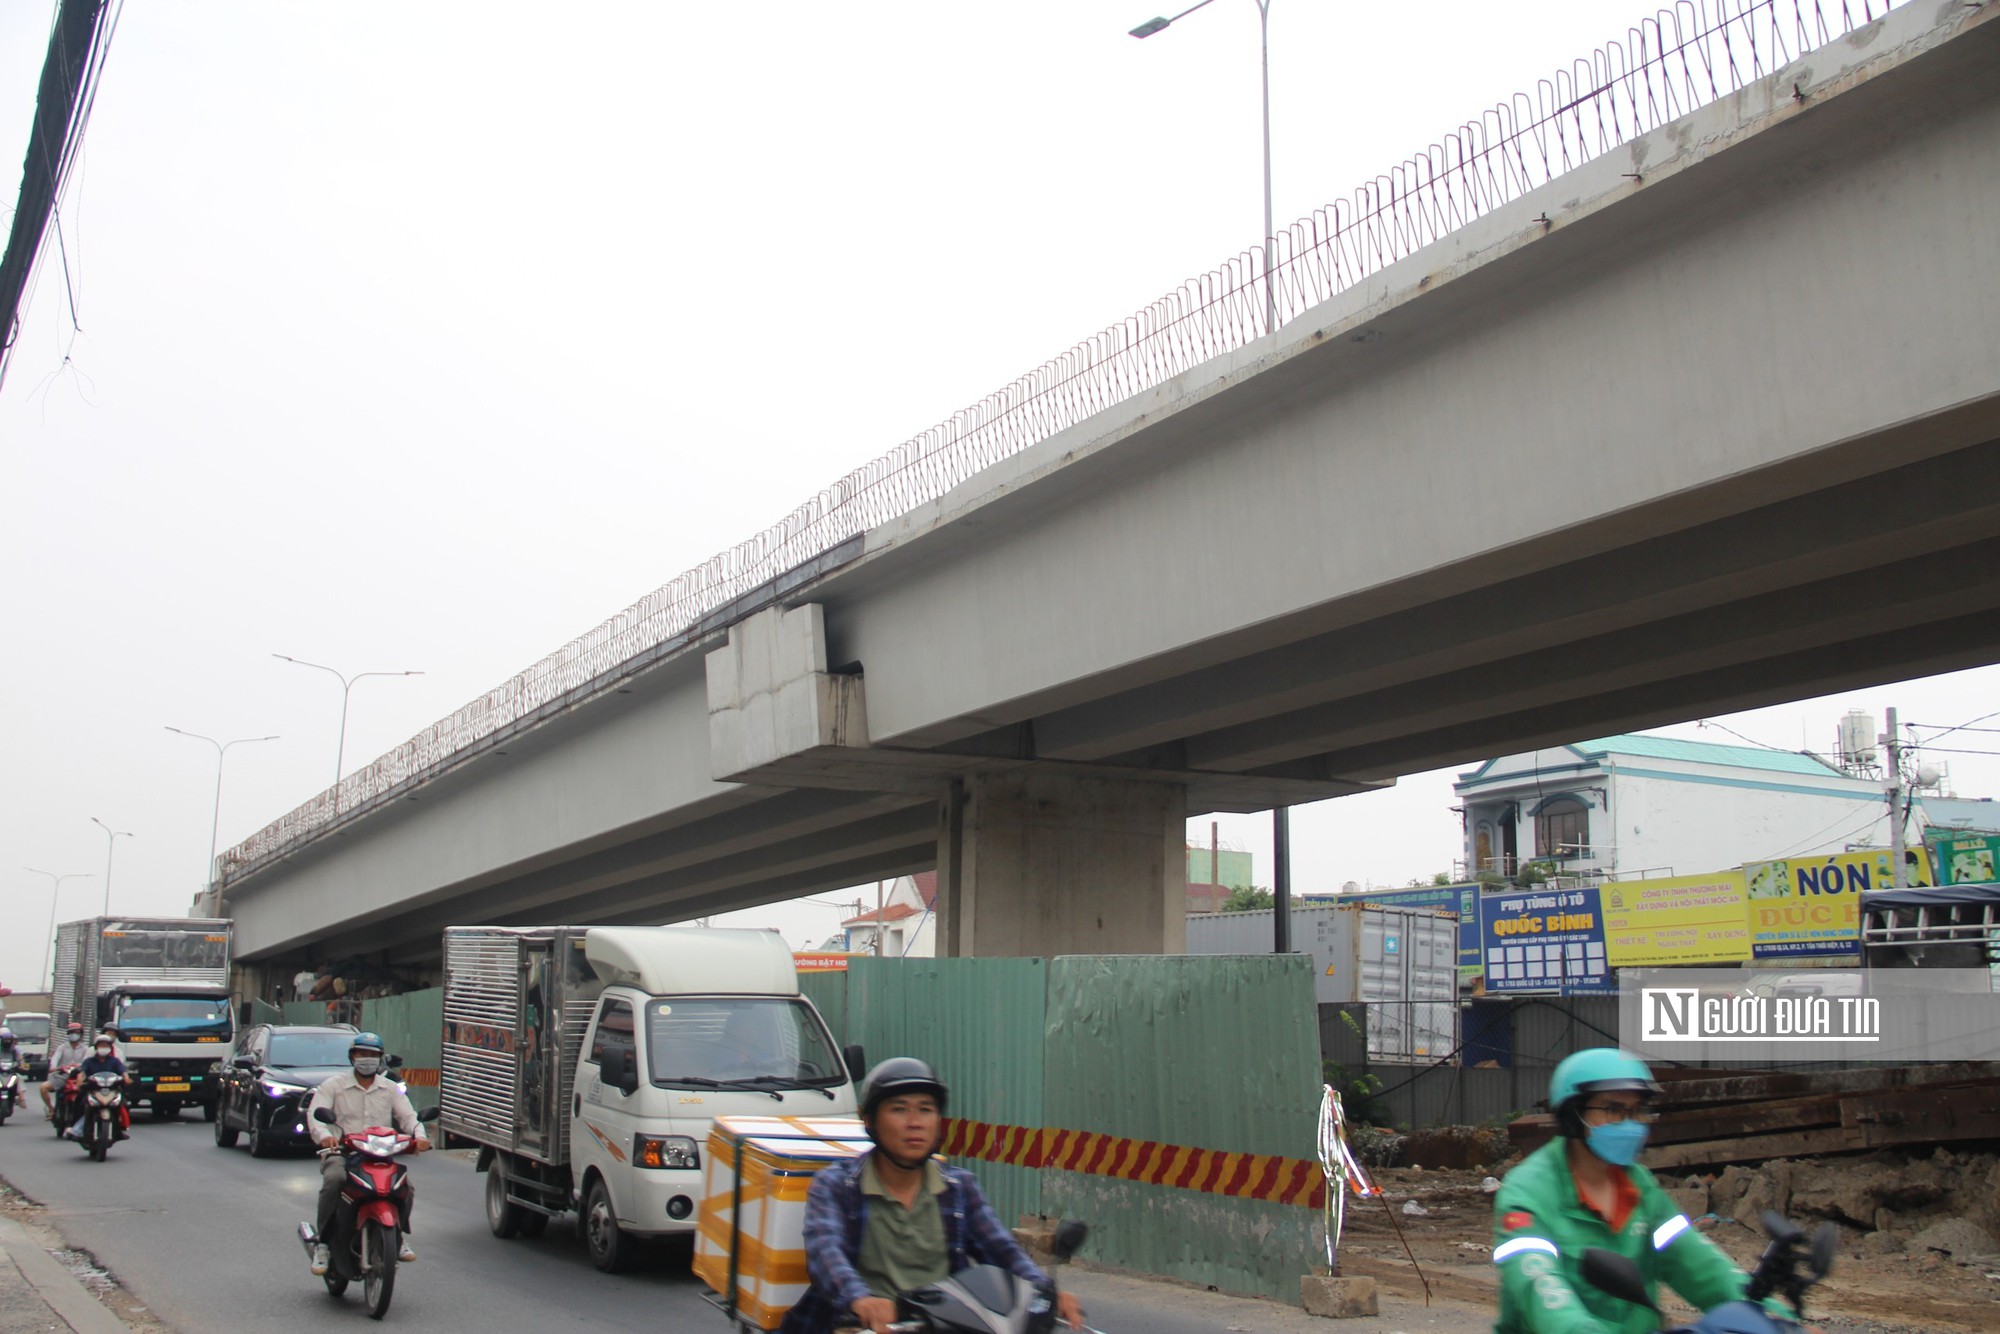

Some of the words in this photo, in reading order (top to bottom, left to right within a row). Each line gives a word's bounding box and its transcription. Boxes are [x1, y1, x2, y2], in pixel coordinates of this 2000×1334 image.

[1797, 857, 1871, 896] NÓN
[1501, 900, 1524, 912] PHỤ
[1525, 896, 1556, 909] TÙNG
[1569, 892, 1585, 906] TÔ
[1642, 890, 1661, 899] CÔNG
[1662, 890, 1669, 898] TY
[1671, 888, 1688, 896] TNHH
[1494, 913, 1542, 936] QUỐC
[1547, 912, 1594, 932] BÌNH
[1759, 901, 1832, 927] ĐỨC
